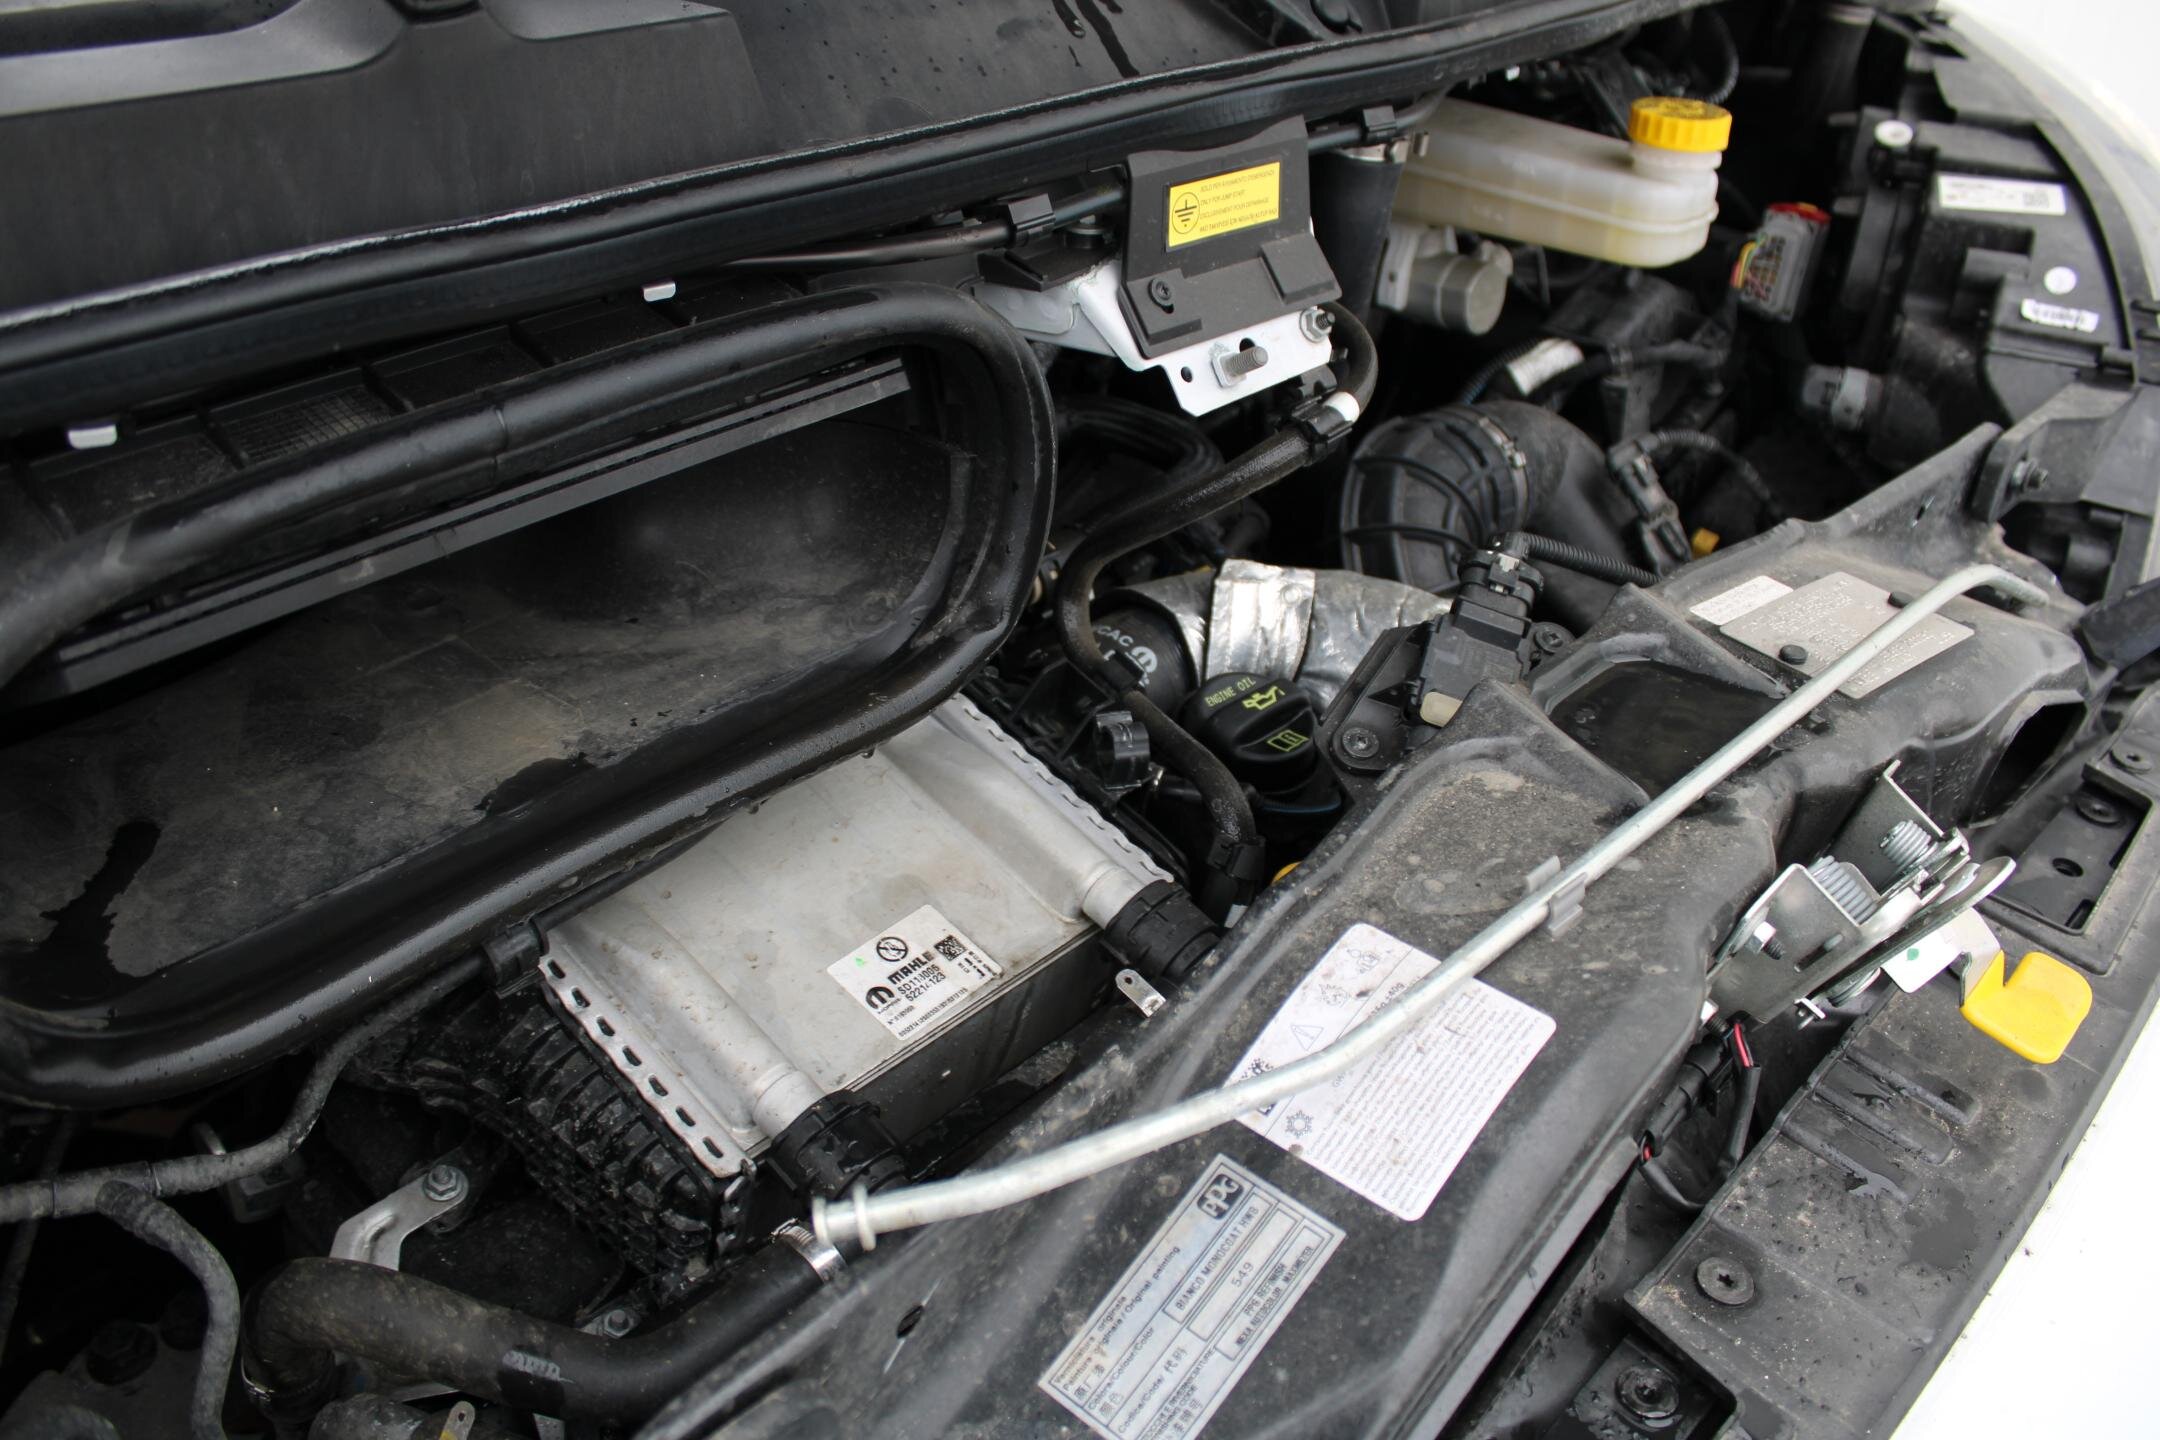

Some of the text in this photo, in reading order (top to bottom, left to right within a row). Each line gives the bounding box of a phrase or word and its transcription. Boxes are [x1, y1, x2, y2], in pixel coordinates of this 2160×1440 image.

[1204, 677, 1256, 707] ENGINE OIL
[886, 949, 935, 986] MAHLE
[1201, 1174, 1243, 1219] PPG
[1151, 1245, 1180, 1279] painting
[1176, 1276, 1205, 1310] BIANCO
[1201, 1227, 1242, 1276] MONOCOAT
[1229, 1260, 1254, 1288] 549
[1244, 1298, 1260, 1316] PPG
